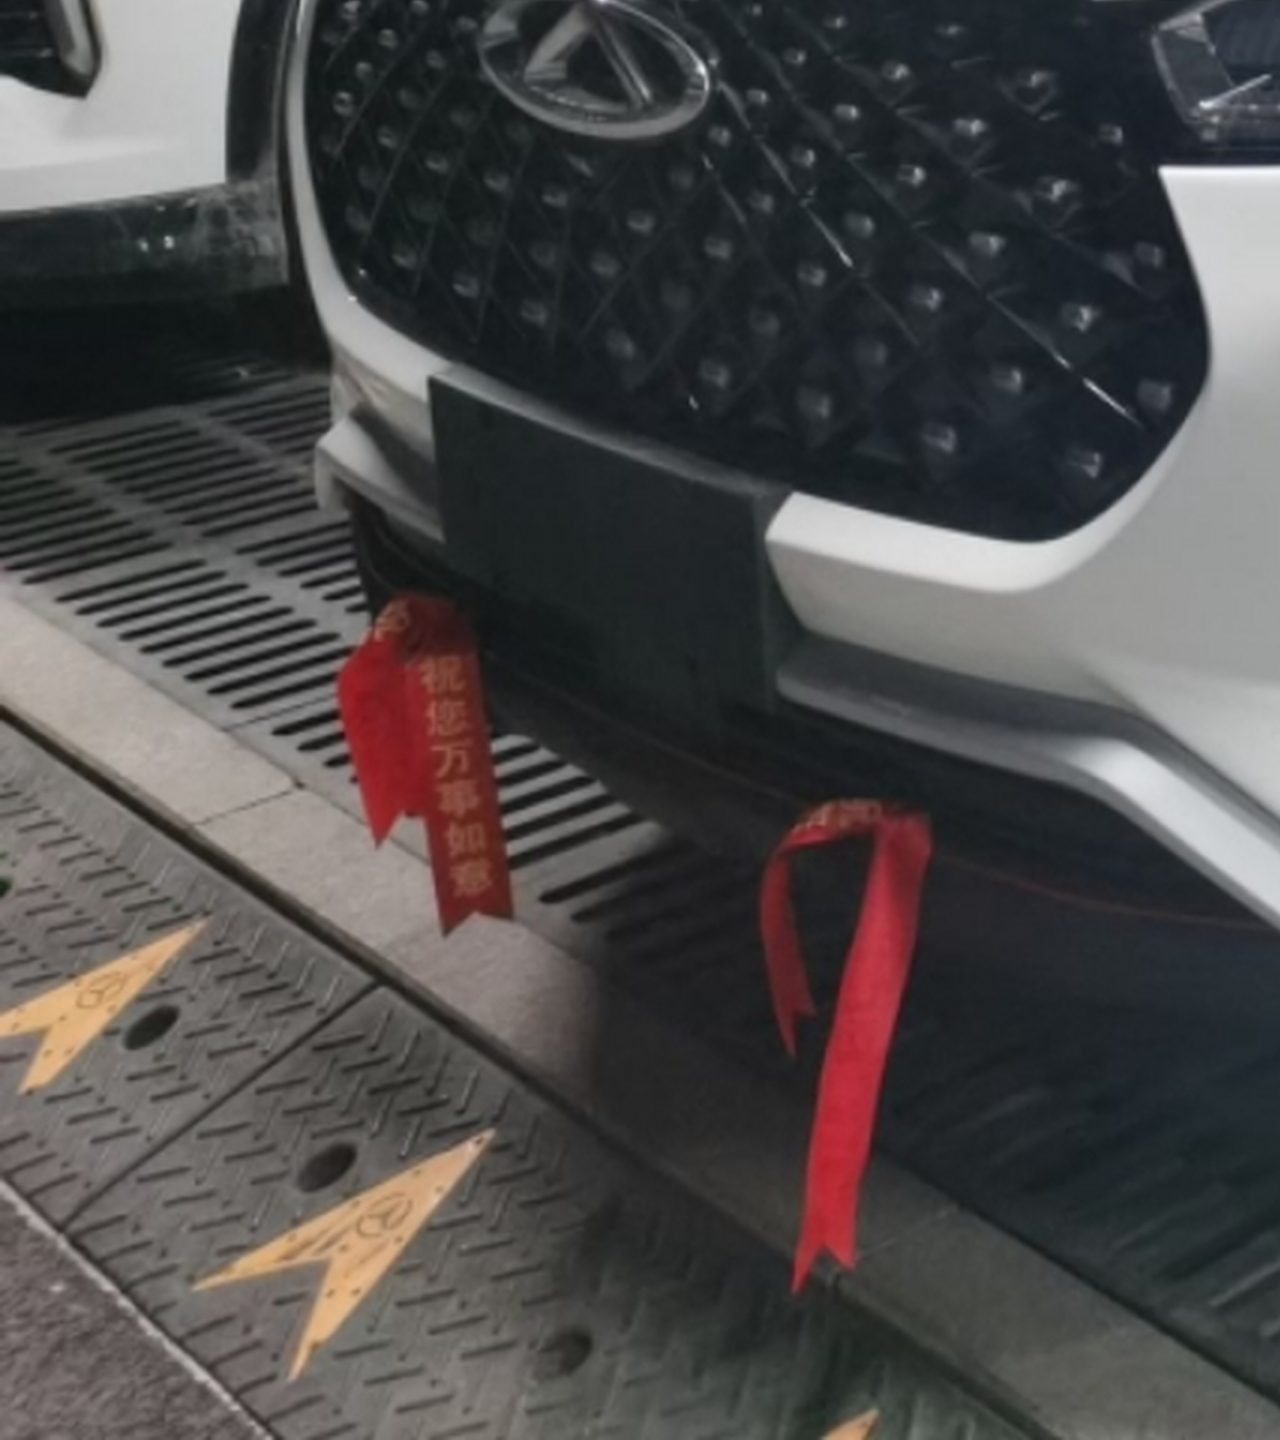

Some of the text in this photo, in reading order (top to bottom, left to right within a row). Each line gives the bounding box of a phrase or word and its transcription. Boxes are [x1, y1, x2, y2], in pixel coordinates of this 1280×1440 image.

[419, 654, 495, 898] 祝您万事如意
